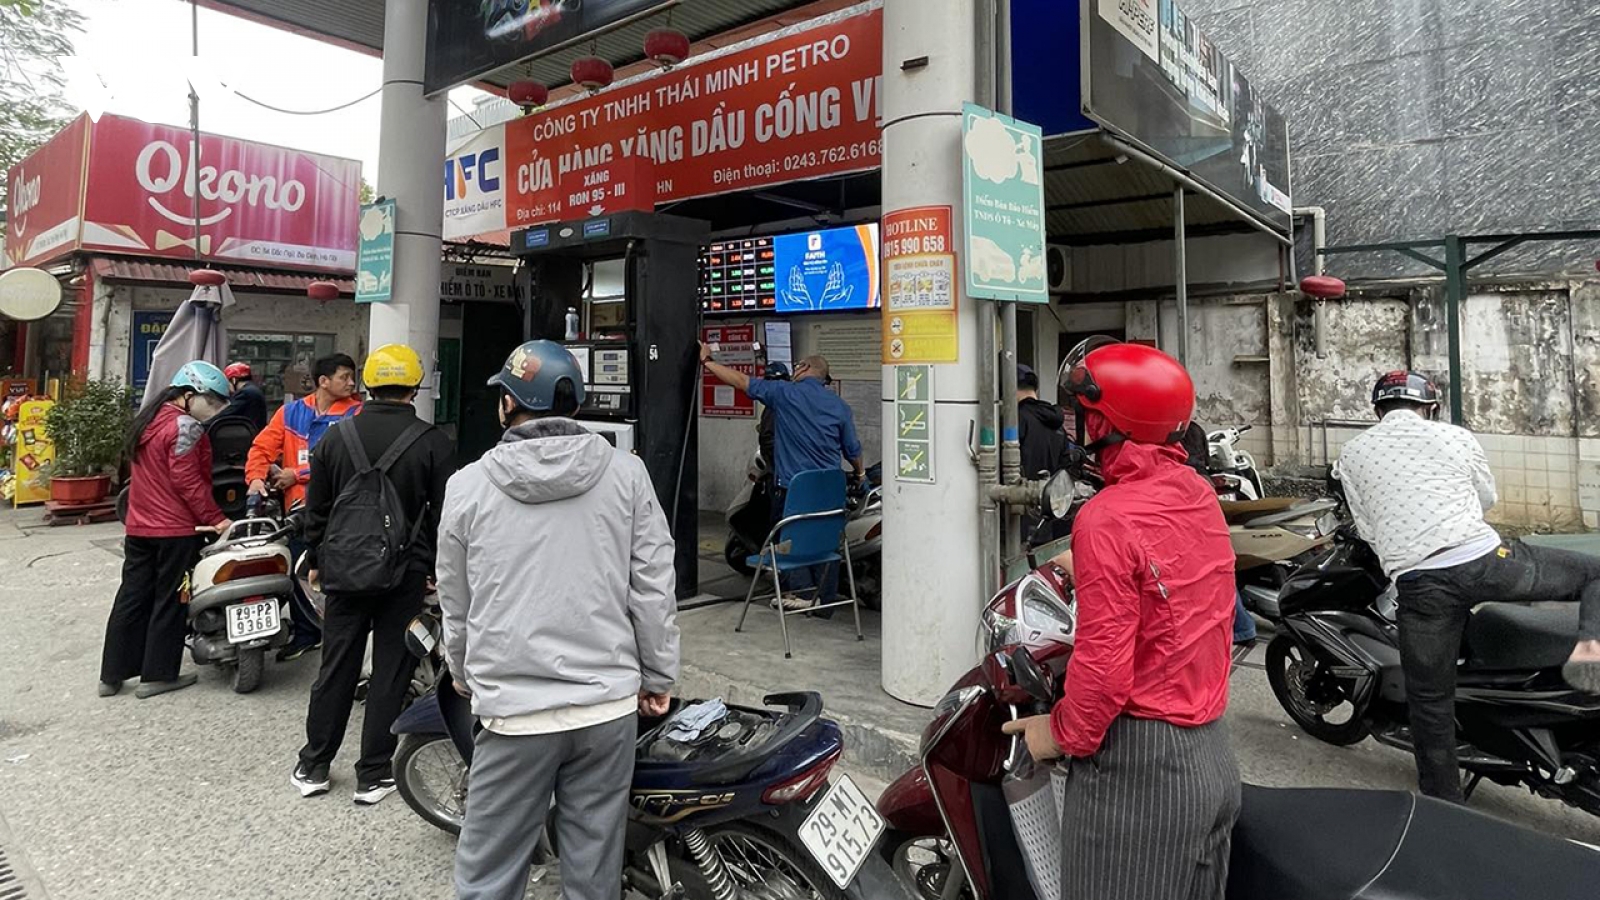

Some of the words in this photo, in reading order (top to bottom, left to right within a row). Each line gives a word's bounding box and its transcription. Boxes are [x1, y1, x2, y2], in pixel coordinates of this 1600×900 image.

[534, 114, 576, 142] CÔNG
[580, 106, 600, 130] TY
[604, 91, 650, 122] TNHH
[655, 75, 700, 107] THÁI
[705, 60, 759, 96] MINH
[766, 33, 850, 79] PETRO
[517, 149, 553, 195] CỬA
[691, 101, 746, 157] DẦU
[754, 82, 841, 143] CỐNG
[713, 167, 741, 186] Điện
[744, 159, 780, 178] thoại:
[517, 207, 529, 222] Địa
[548, 201, 562, 214] 114
[657, 179, 673, 194] HN
[569, 192, 589, 207] RON
[591, 188, 605, 203] 95
[614, 183, 625, 197] III
[886, 218, 938, 236] HOTLINE
[901, 237, 920, 255] 990
[923, 234, 945, 252] 658
[236, 602, 272, 620] 29-P2
[237, 616, 272, 635] 9368
[811, 784, 857, 849] 29-M1
[827, 805, 880, 879] 915.73
